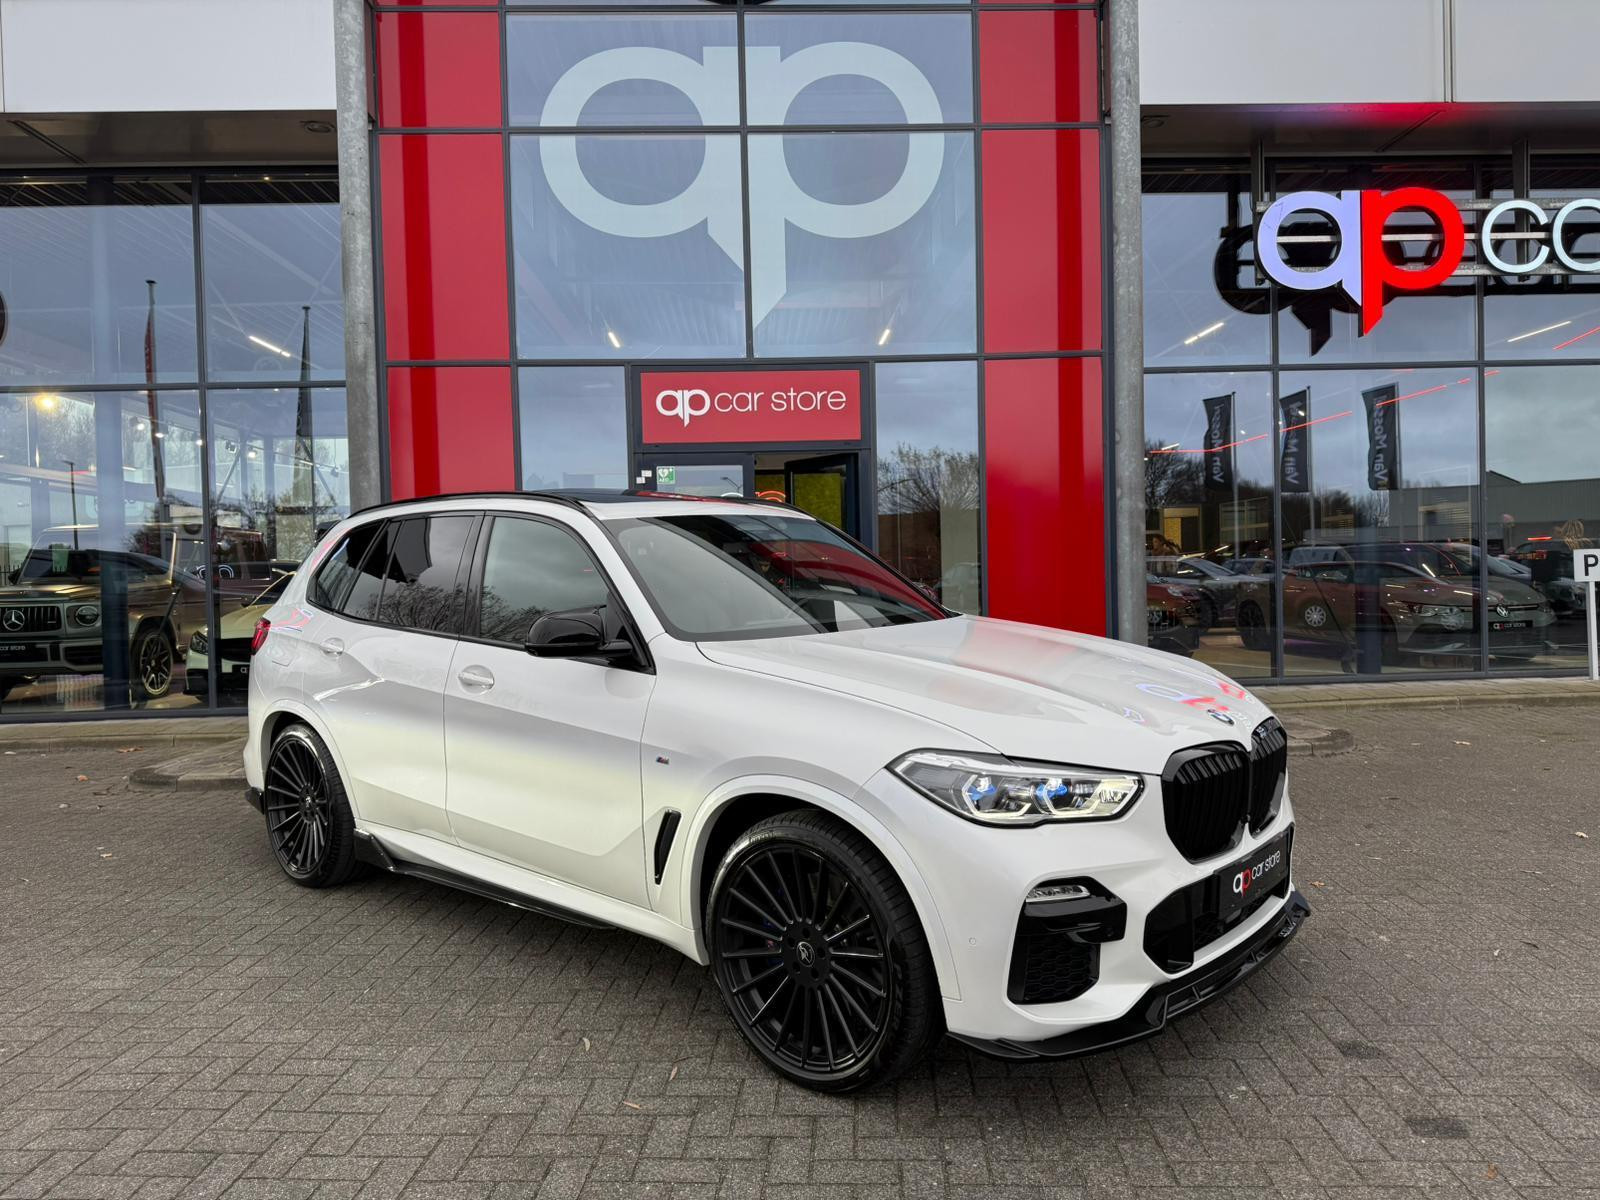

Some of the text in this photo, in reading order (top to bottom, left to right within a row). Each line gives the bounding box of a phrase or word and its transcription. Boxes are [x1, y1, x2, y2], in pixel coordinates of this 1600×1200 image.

[1257, 187, 1465, 336] ap
[655, 387, 847, 428] ap car store
[1583, 554, 1599, 576] P
[1233, 850, 1281, 897] ap car store
